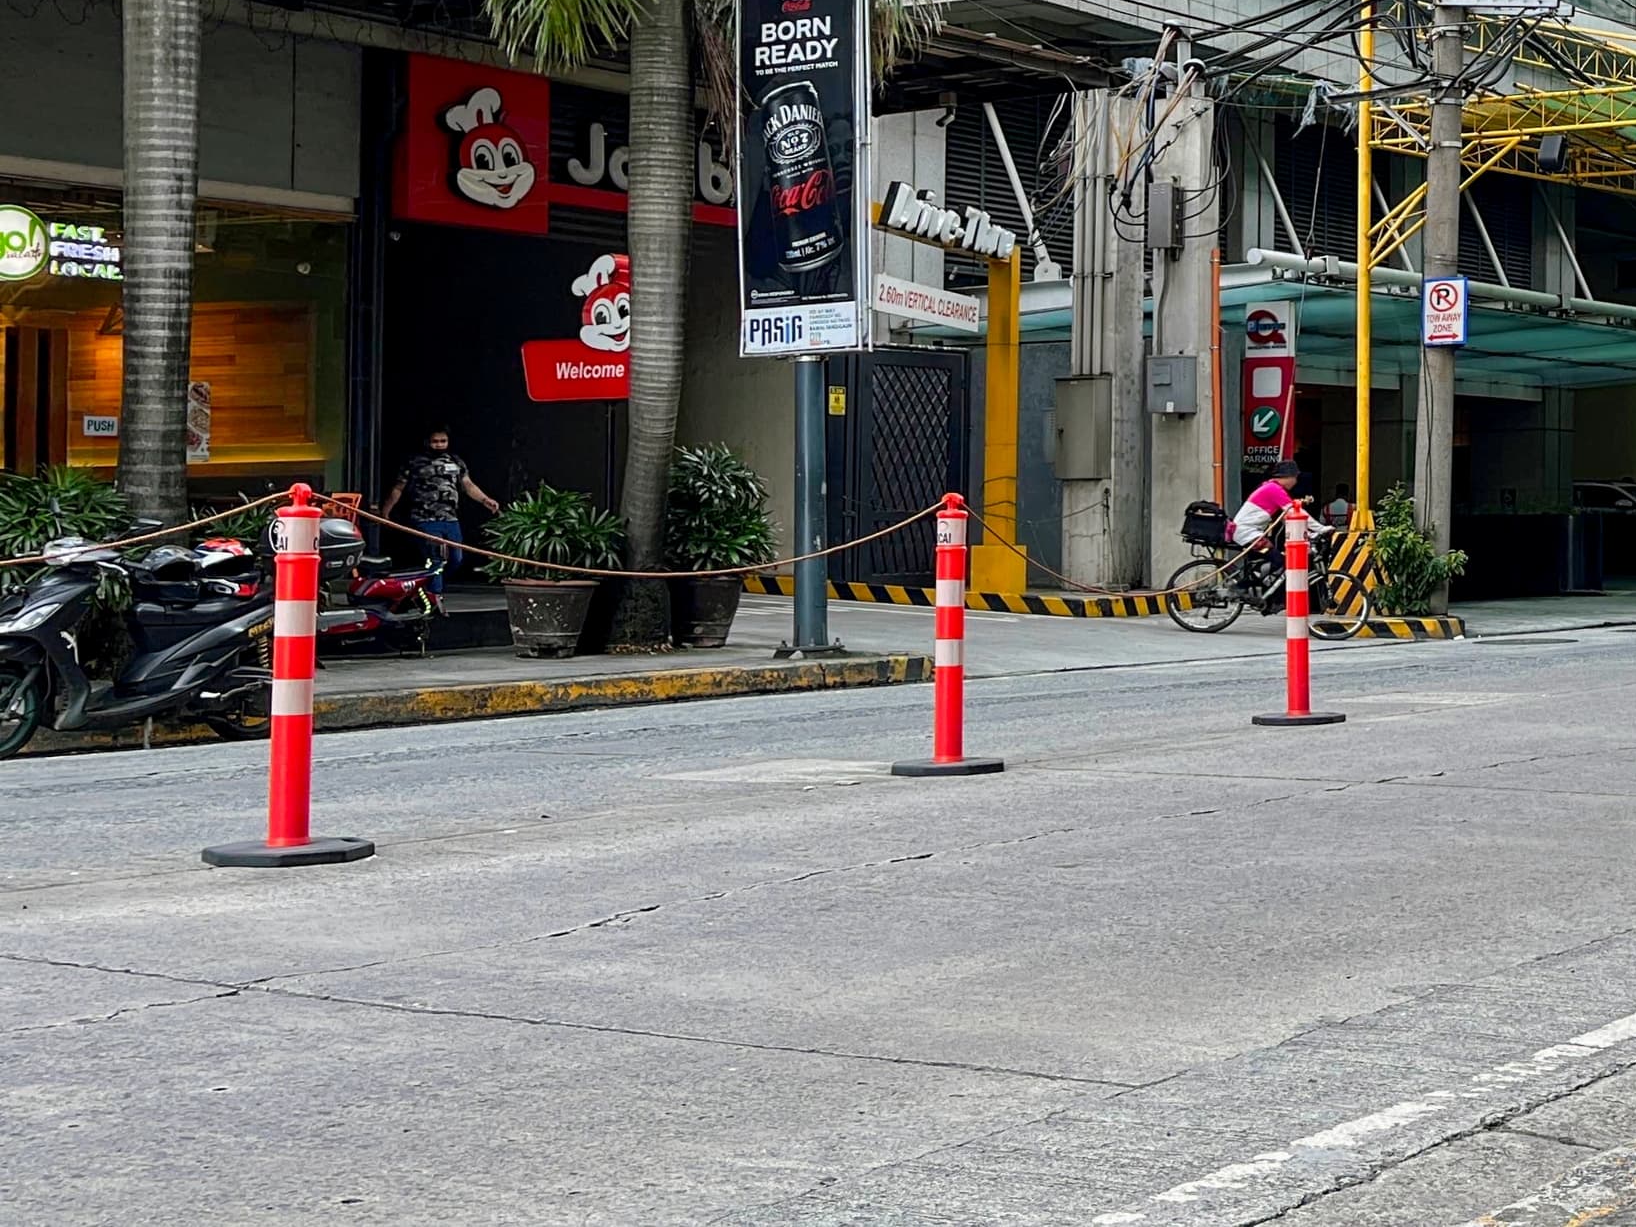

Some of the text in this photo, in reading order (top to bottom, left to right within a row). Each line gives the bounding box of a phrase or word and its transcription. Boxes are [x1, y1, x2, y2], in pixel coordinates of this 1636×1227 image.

[761, 15, 831, 43] BORN
[755, 37, 839, 67] READY
[775, 66, 787, 74] THE
[788, 63, 815, 73] PERFECT
[815, 60, 839, 69] MATCH
[879, 283, 977, 324] 2.60m VERTICAL CLEARANCE
[1426, 312, 1462, 323] TOW AWAY
[1432, 324, 1453, 333] ZONE
[556, 361, 625, 380] Welcome
[87, 419, 115, 432] PUSH
[1247, 445, 1279, 454] OFFICE
